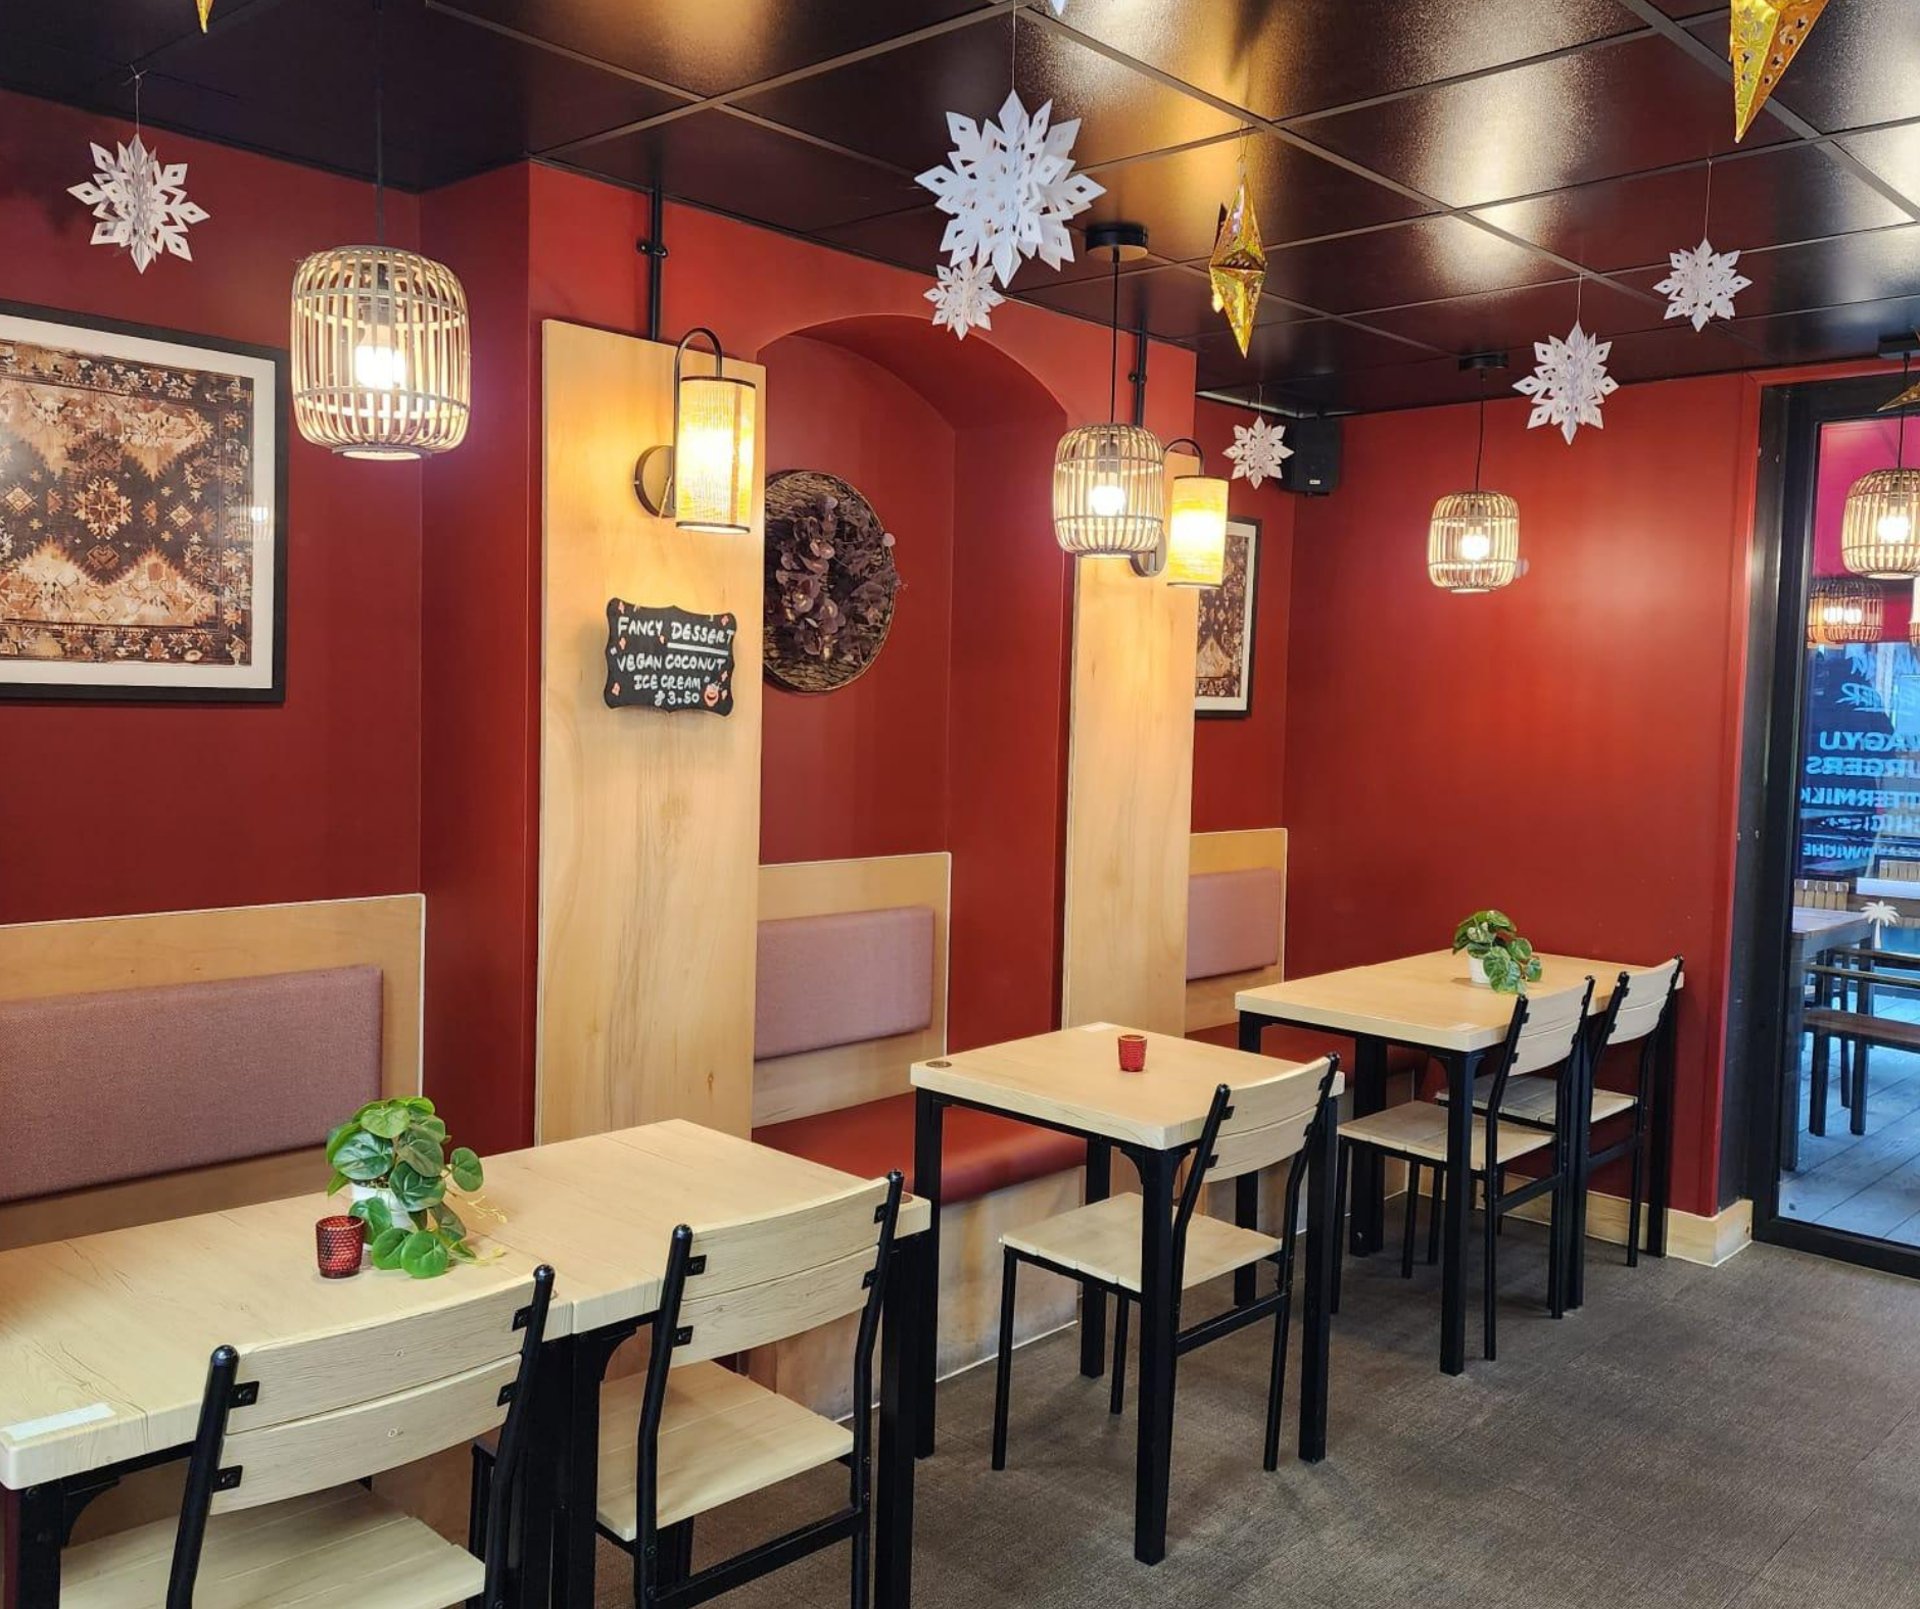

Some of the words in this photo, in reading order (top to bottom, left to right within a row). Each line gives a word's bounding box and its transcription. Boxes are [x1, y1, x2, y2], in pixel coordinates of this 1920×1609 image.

[617, 616, 663, 636] FANCY
[671, 621, 735, 644] DESSERT
[617, 653, 662, 672] VEGAN
[665, 653, 726, 671] COCONUT
[633, 674, 659, 690] ICE
[661, 675, 701, 690] CREAM
